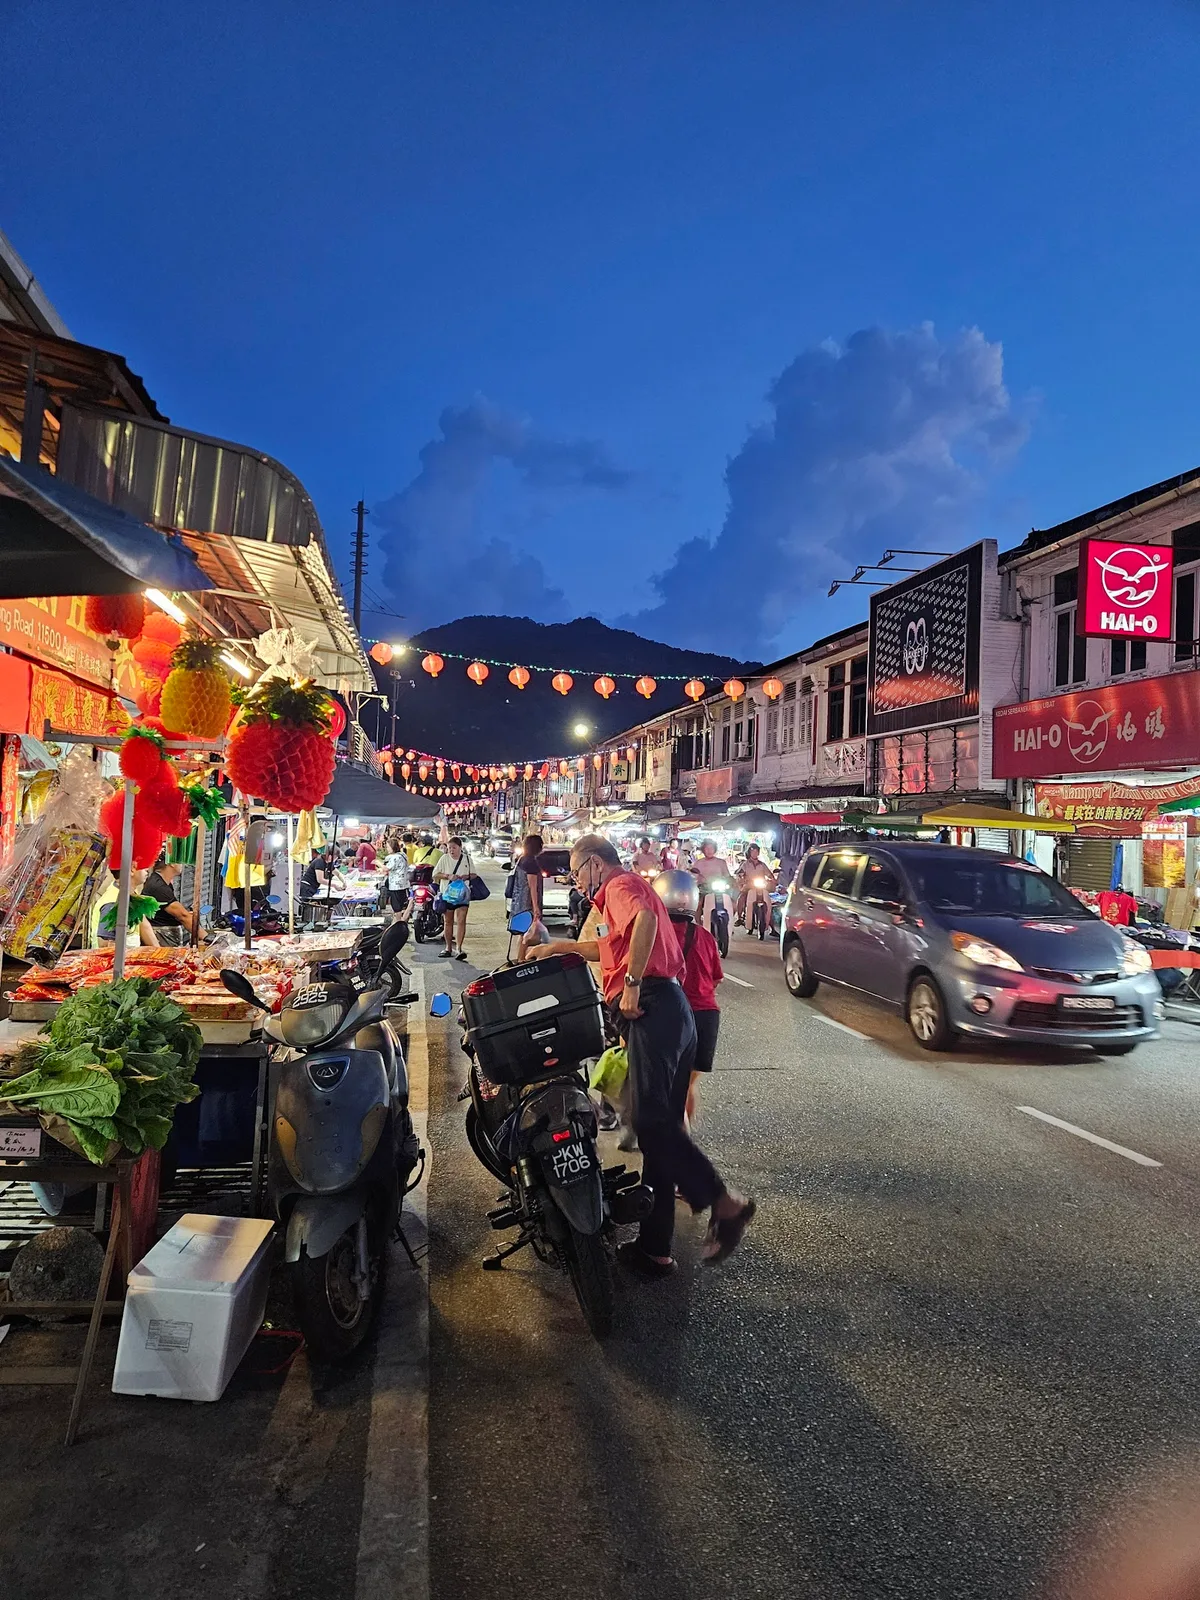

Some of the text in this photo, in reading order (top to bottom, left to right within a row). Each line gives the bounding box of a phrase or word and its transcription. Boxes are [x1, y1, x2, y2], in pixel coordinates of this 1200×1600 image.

[14, 609, 35, 640] Road,
[37, 622, 62, 651] 11500
[1100, 611, 1158, 634] HAI-O
[1013, 724, 1061, 752] HAI-O
[1061, 784, 1107, 802] Hamper
[1064, 804, 1146, 821] 最实在的新春好礼
[516, 965, 540, 978] GIVI
[292, 991, 329, 1008] 2925
[552, 1141, 584, 1165] PKW
[553, 1155, 591, 1178] 1706
